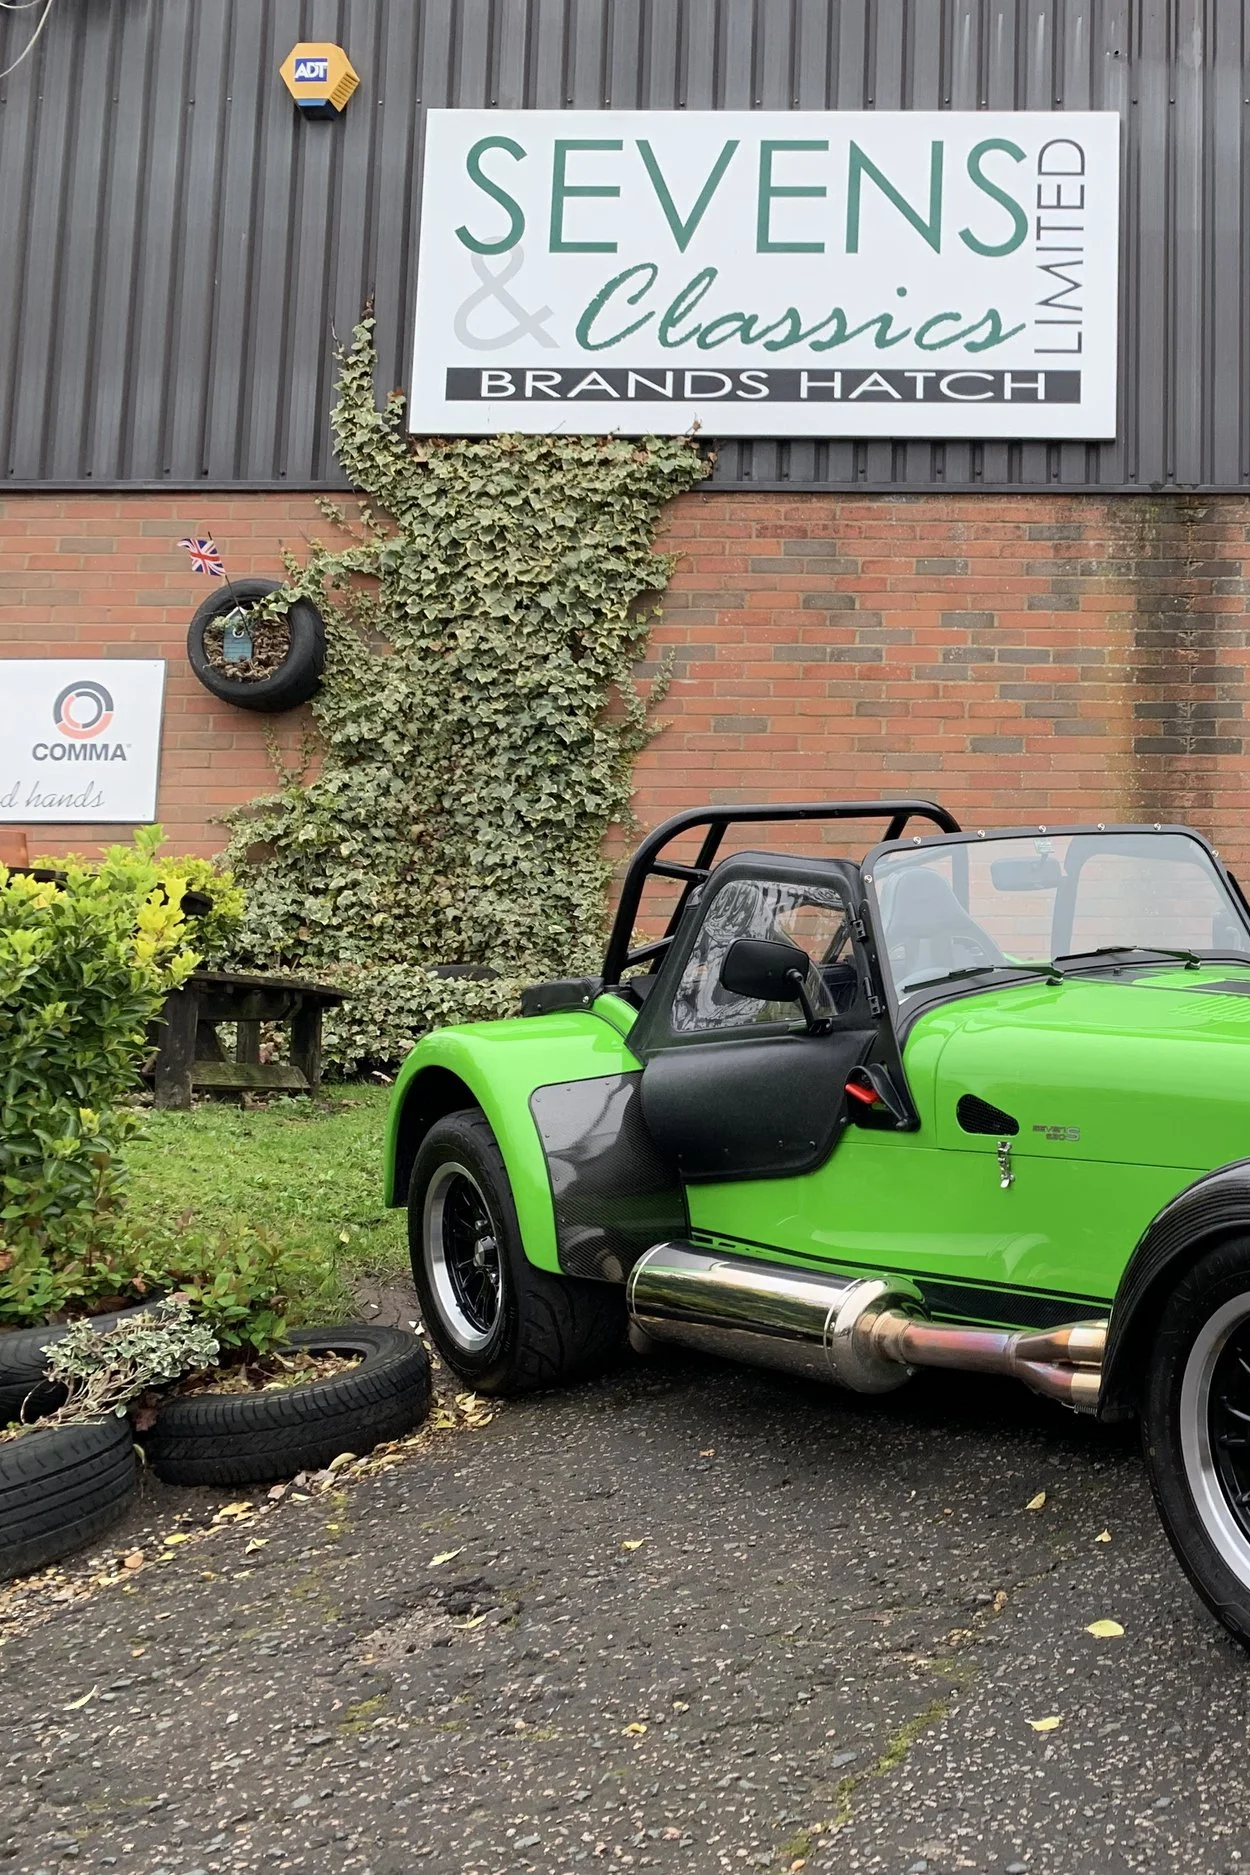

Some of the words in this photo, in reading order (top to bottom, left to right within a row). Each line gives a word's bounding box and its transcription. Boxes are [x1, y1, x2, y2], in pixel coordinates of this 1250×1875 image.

[294, 61, 328, 79] ADT
[454, 135, 1029, 258] SEVENS
[1034, 138, 1086, 354] LIMITED
[453, 236, 560, 351] &
[574, 261, 1027, 353] Classics
[480, 370, 769, 399] BRANDS
[800, 371, 1046, 400] HATCH
[32, 742, 127, 761] COMMA
[25, 780, 105, 808] hands
